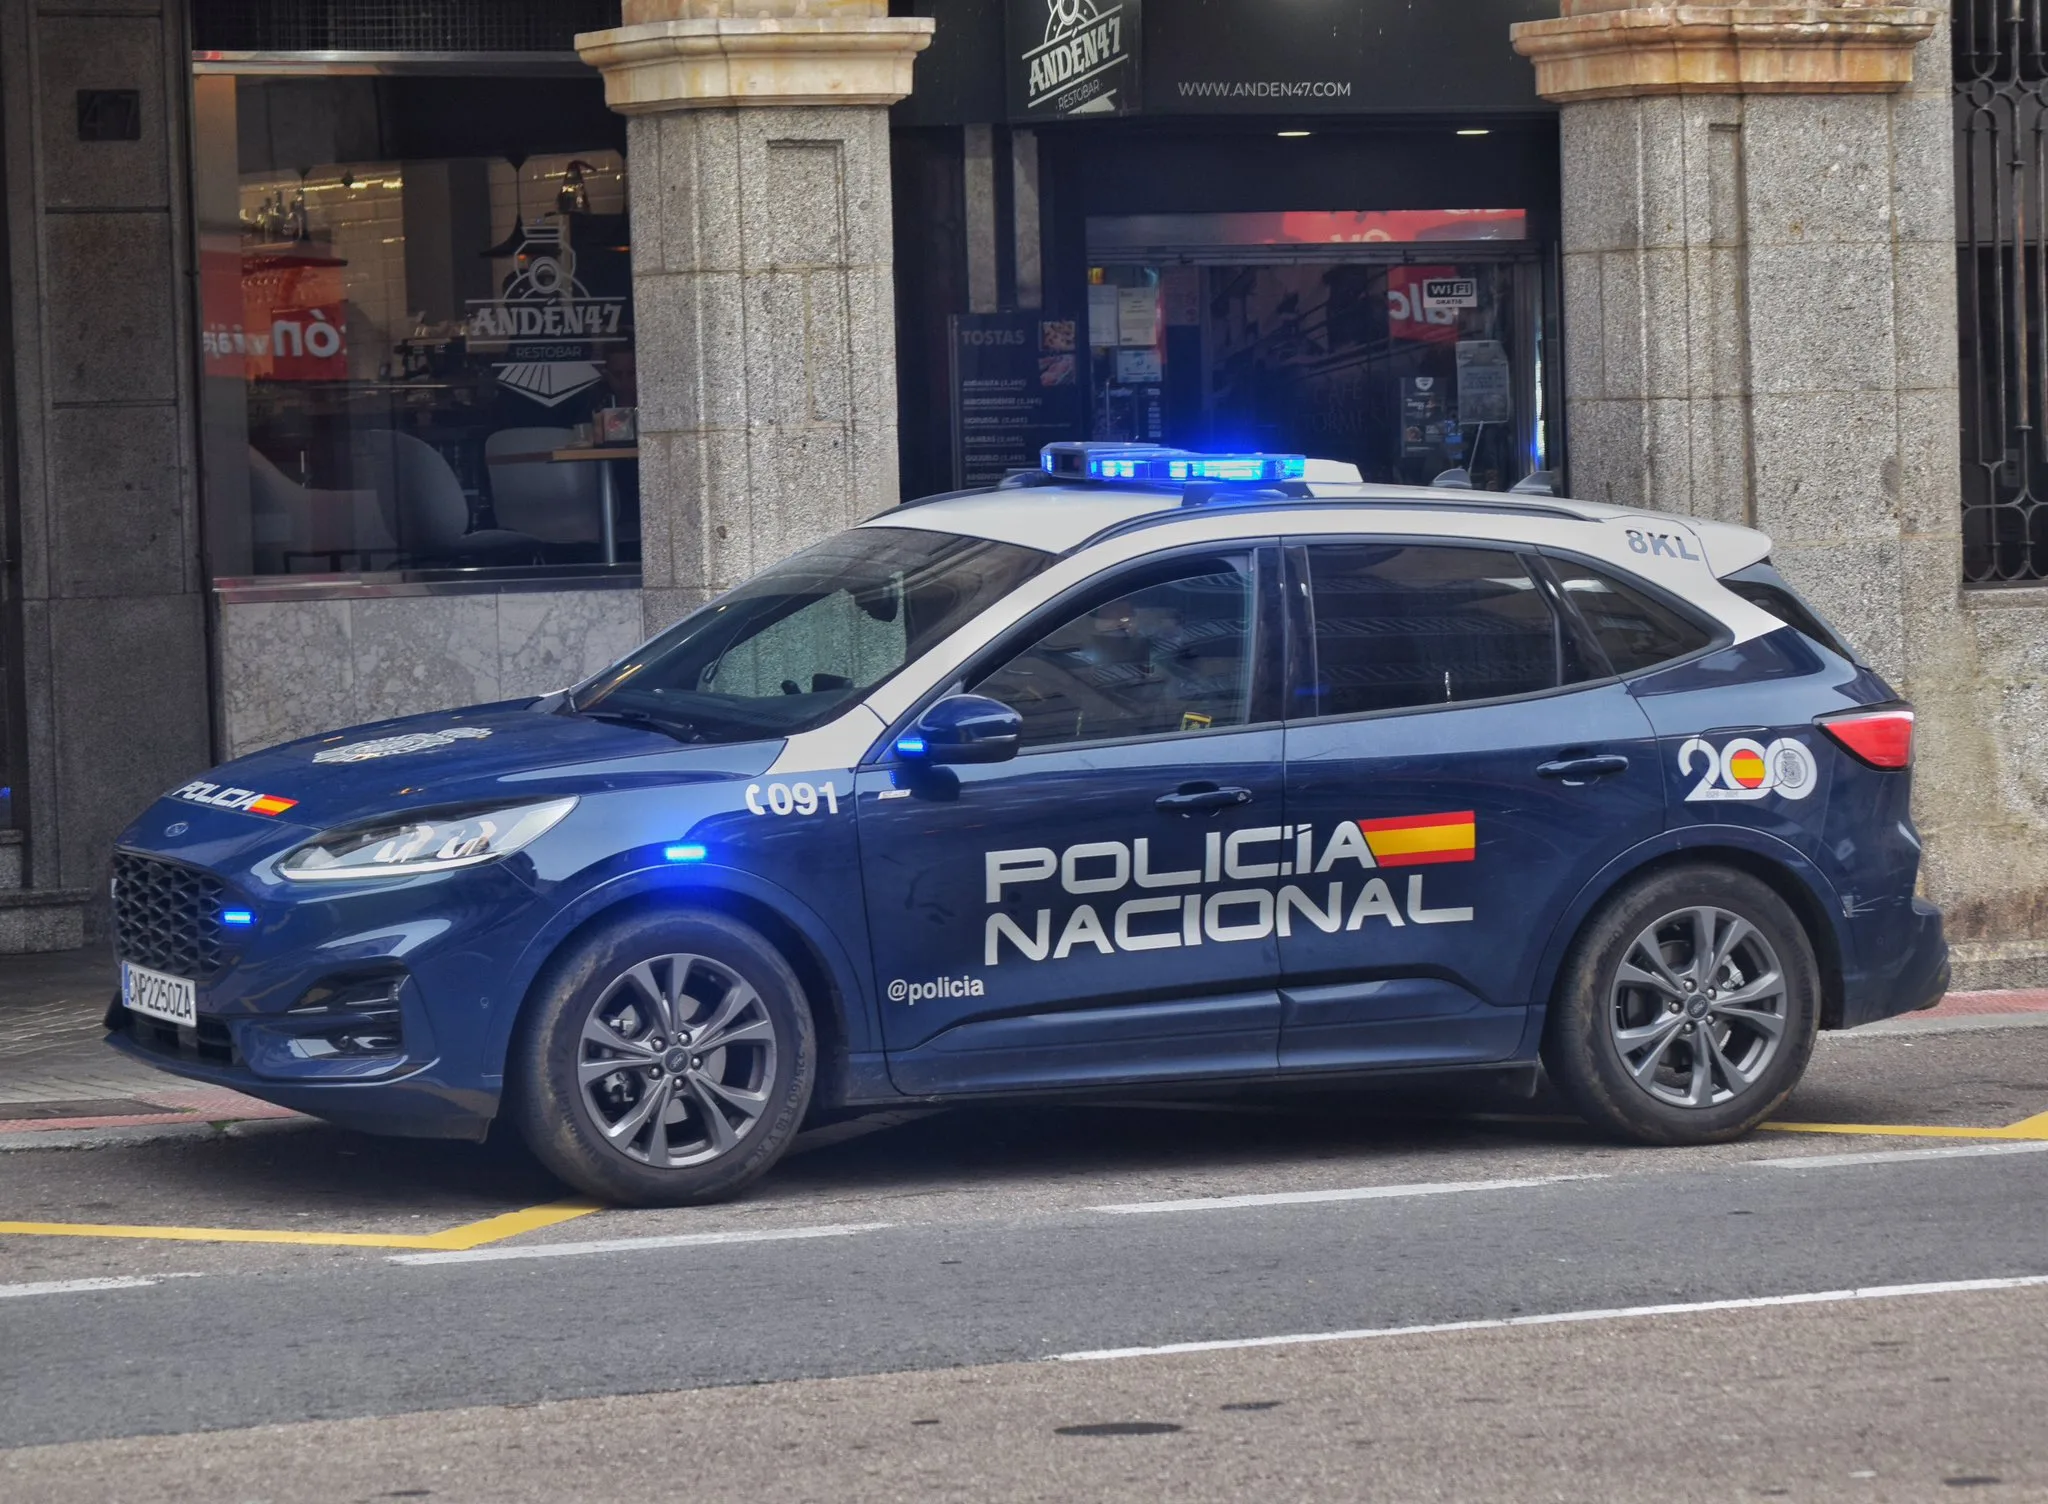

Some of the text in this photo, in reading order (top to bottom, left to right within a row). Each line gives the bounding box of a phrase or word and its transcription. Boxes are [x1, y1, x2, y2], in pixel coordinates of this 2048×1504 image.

[1029, 16, 1121, 97] ANDÉN47
[1057, 79, 1100, 111] RESTOBAR
[1177, 81, 1352, 97] WWW.ANDEN47.COM
[82, 92, 138, 137] 47
[471, 298, 622, 336] ANDÉN47
[516, 345, 582, 359] RESTOBAR
[961, 329, 1026, 346] TOSTAS
[1624, 529, 1701, 562] 8KL
[1677, 737, 1818, 802] 200
[767, 781, 839, 816] 091
[983, 873, 1475, 967] NACIONAL
[887, 974, 985, 1006] @policia
